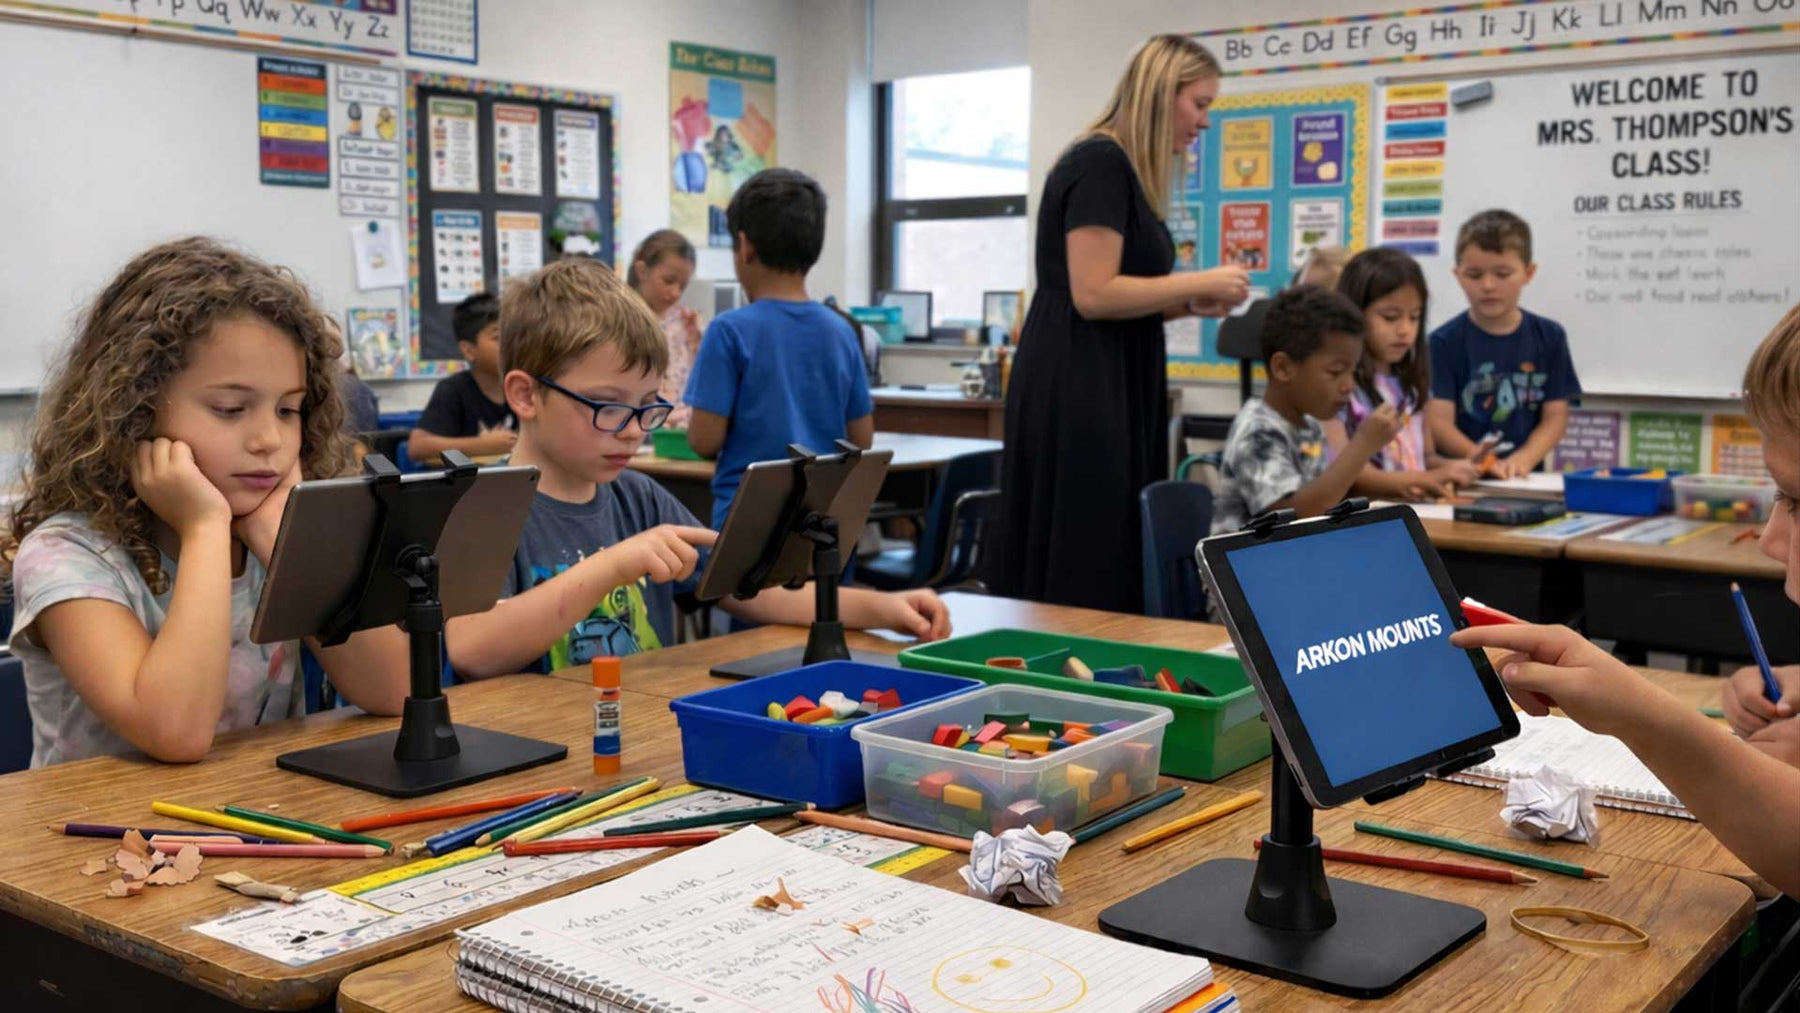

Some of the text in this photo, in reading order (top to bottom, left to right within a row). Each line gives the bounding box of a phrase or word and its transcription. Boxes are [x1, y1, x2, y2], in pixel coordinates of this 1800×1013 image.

[196, 0, 230, 23] Qq
[240, 0, 280, 22] Ww
[291, 5, 317, 28] Xx
[329, 11, 354, 40] Yy
[367, 15, 390, 38] Zz
[1226, 39, 1252, 60] Bb
[1303, 31, 1334, 54] Dd
[1346, 26, 1372, 49] Ef
[1384, 24, 1417, 52] Gg
[1431, 20, 1462, 40] Hh
[1480, 15, 1496, 37] Ii
[1511, 11, 1535, 40] Jj
[1553, 8, 1581, 31] Kk
[1600, 3, 1622, 27] Ll
[1639, 0, 1686, 22] Mm
[1702, 0, 1737, 16] Nn
[1571, 69, 1759, 107] WELCOME TO
[1537, 106, 1794, 146] MRS. THOMPSON'S
[1612, 149, 1711, 178] CLASS!
[1574, 190, 1743, 213] OUR CLASS RULES
[1296, 614, 1442, 674] ARKON MOUNTS
